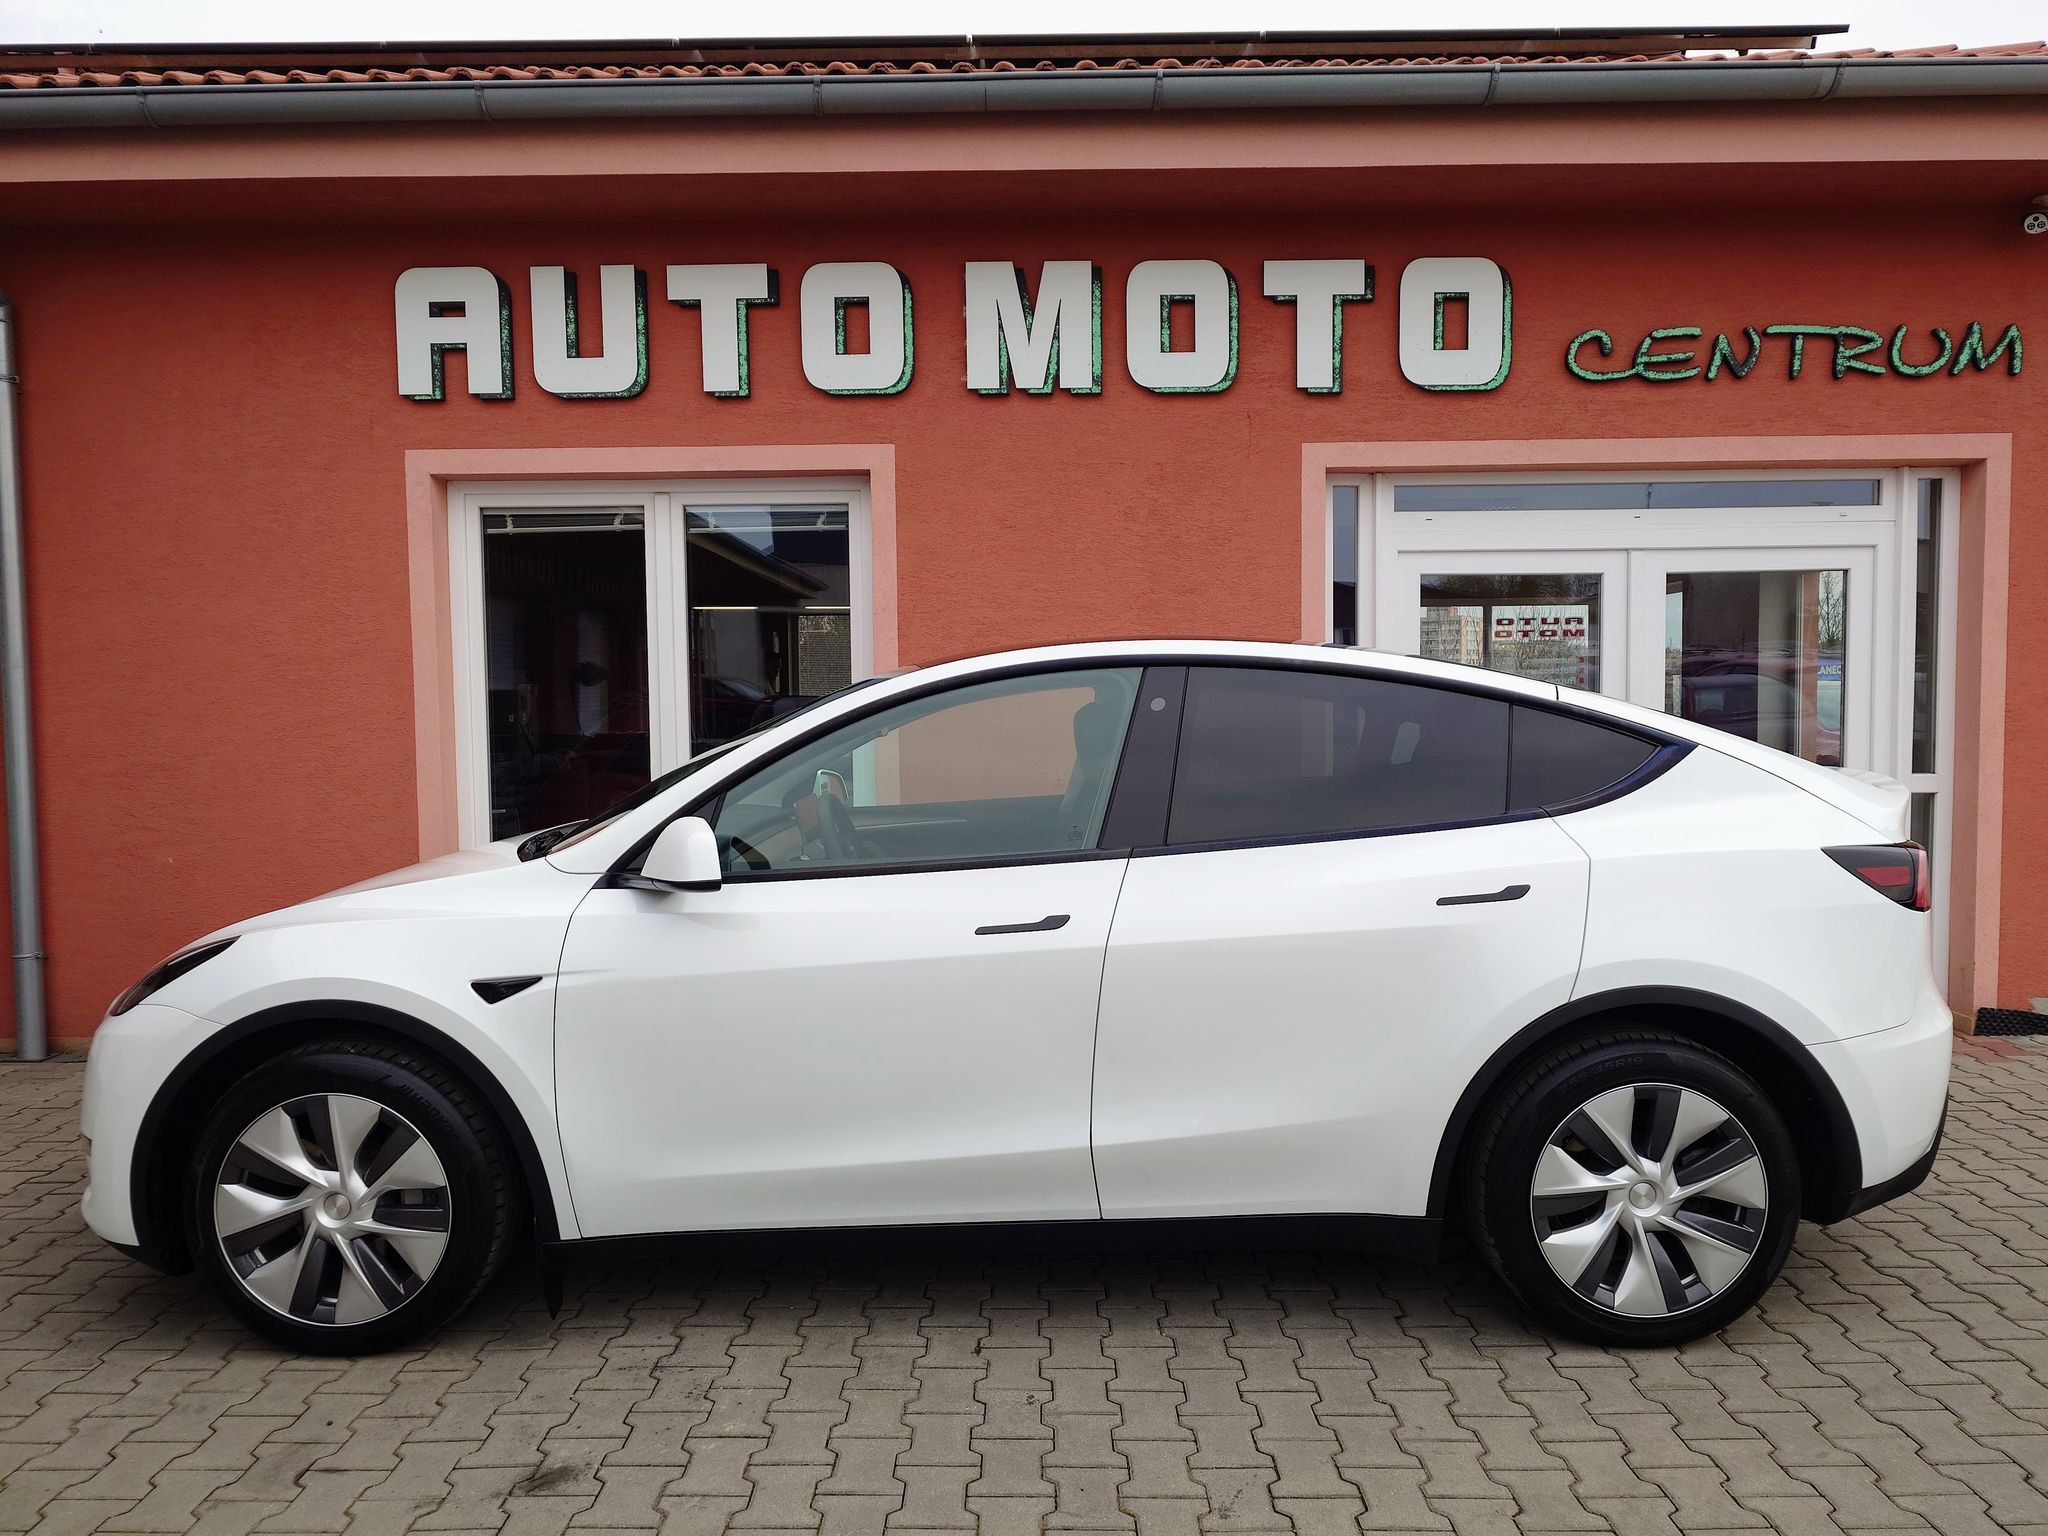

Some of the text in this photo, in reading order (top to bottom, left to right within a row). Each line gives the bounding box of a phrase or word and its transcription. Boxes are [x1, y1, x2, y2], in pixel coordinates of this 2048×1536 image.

[394, 256, 2024, 400] AUTO MOTO CENTRUM
